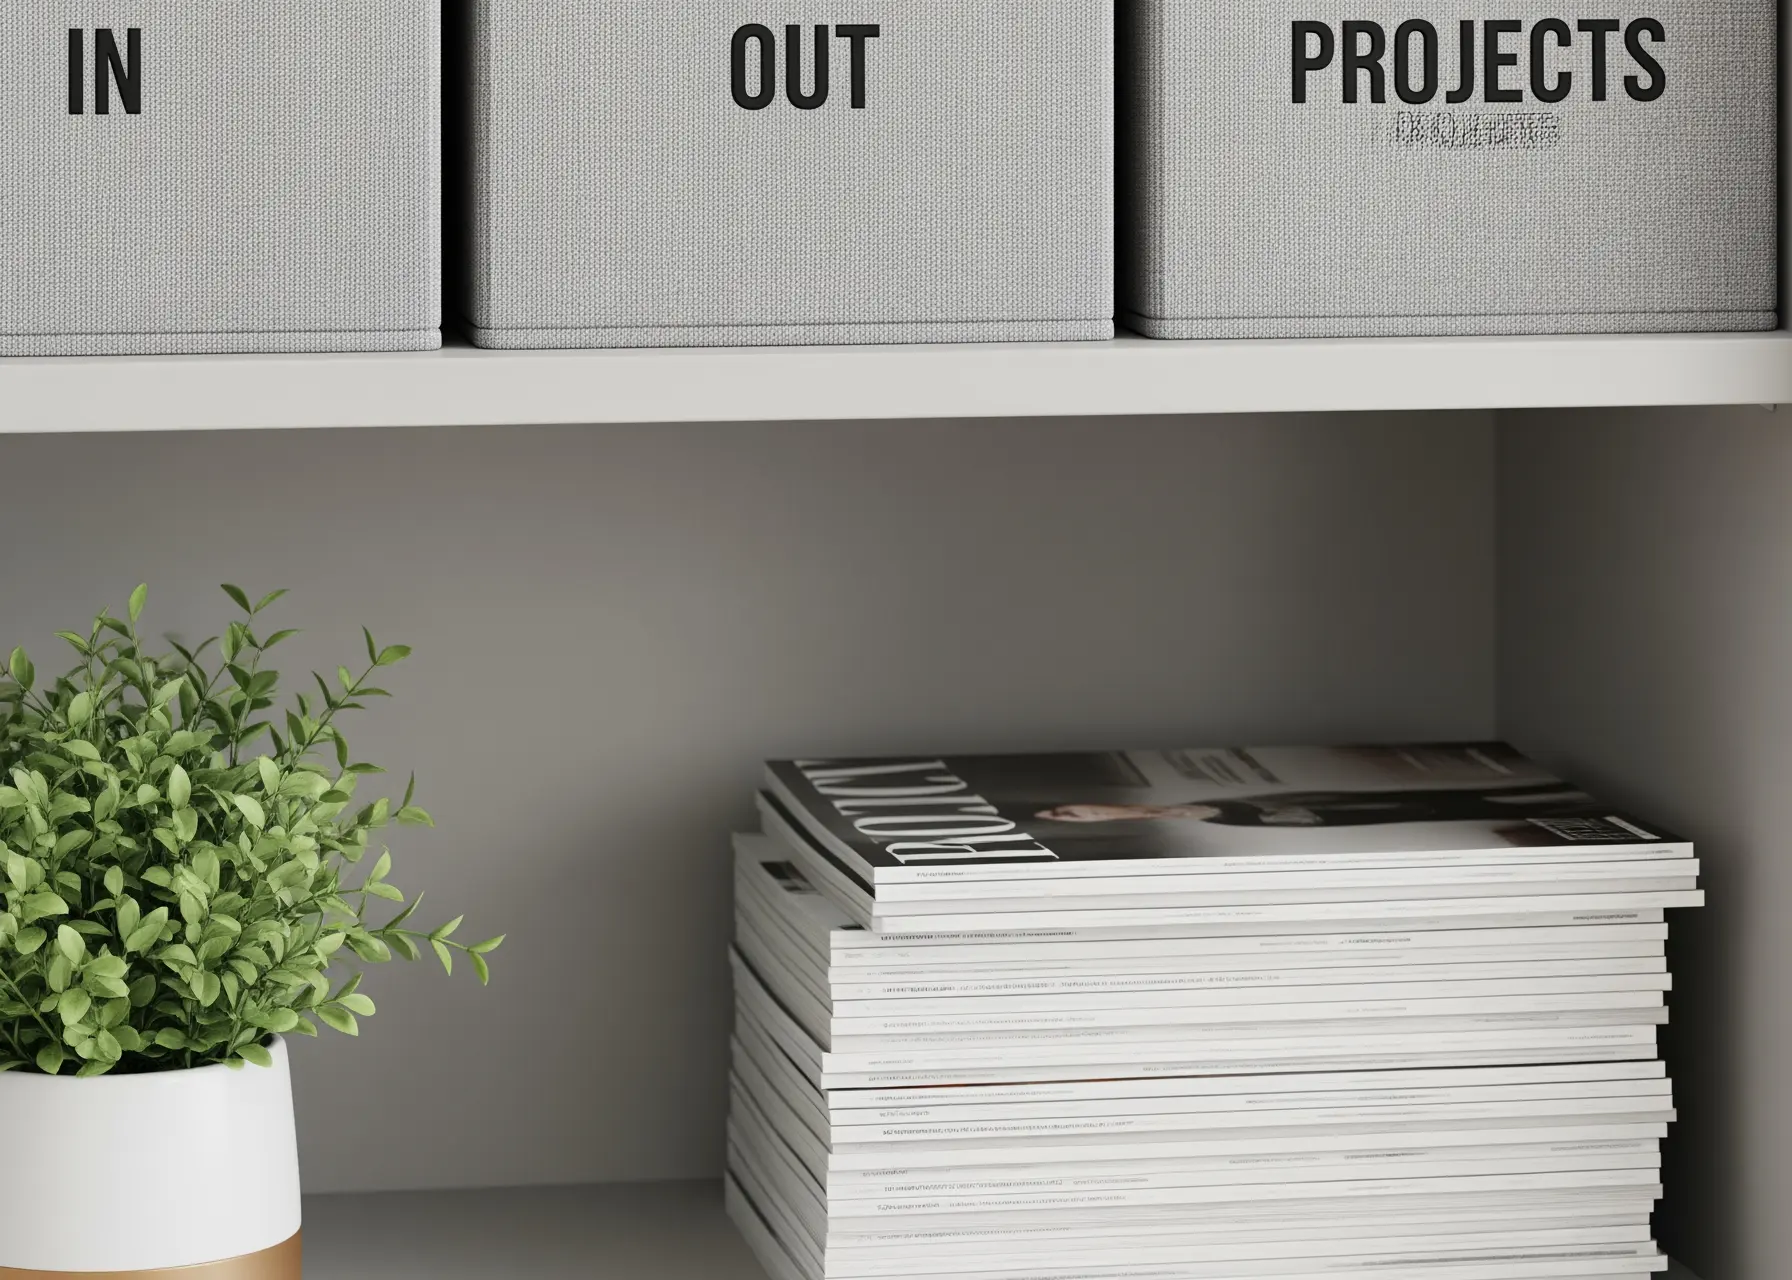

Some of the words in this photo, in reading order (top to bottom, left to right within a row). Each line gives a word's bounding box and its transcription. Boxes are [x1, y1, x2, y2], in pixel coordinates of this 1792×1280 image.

[68, 28, 141, 115] IN
[731, 23, 880, 110] OUT
[1291, 17, 1666, 105] PROJECTS
